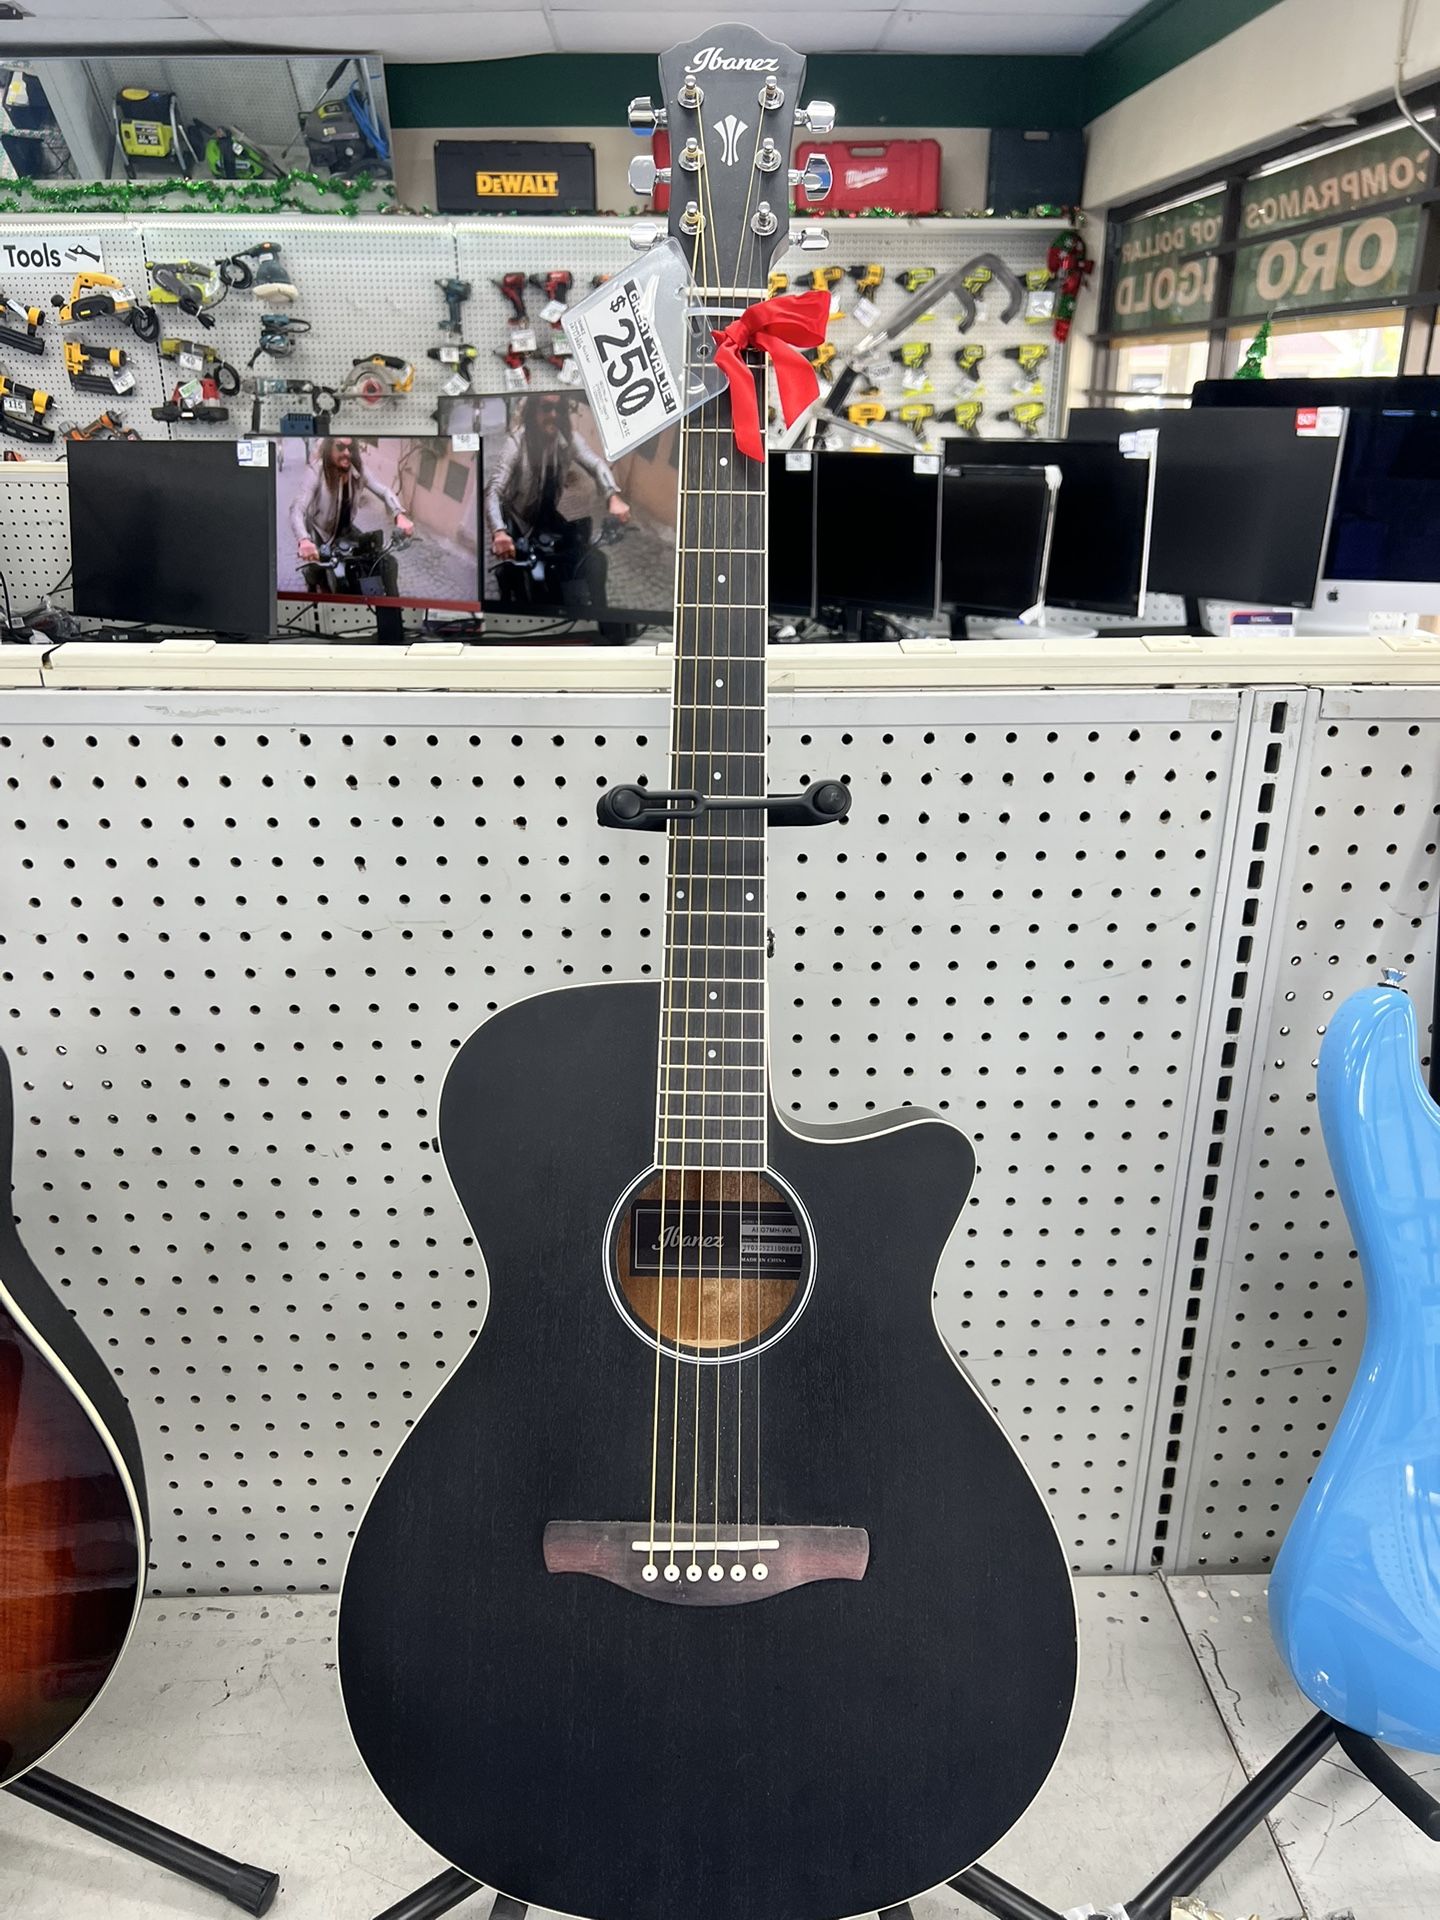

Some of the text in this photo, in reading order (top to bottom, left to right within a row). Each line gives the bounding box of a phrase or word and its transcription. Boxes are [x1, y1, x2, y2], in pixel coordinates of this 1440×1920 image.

[684, 47, 780, 73] Ibanez
[3, 242, 61, 268] Tools
[648, 348, 677, 411] VALUE!
[651, 1225, 725, 1250] Ibanez
